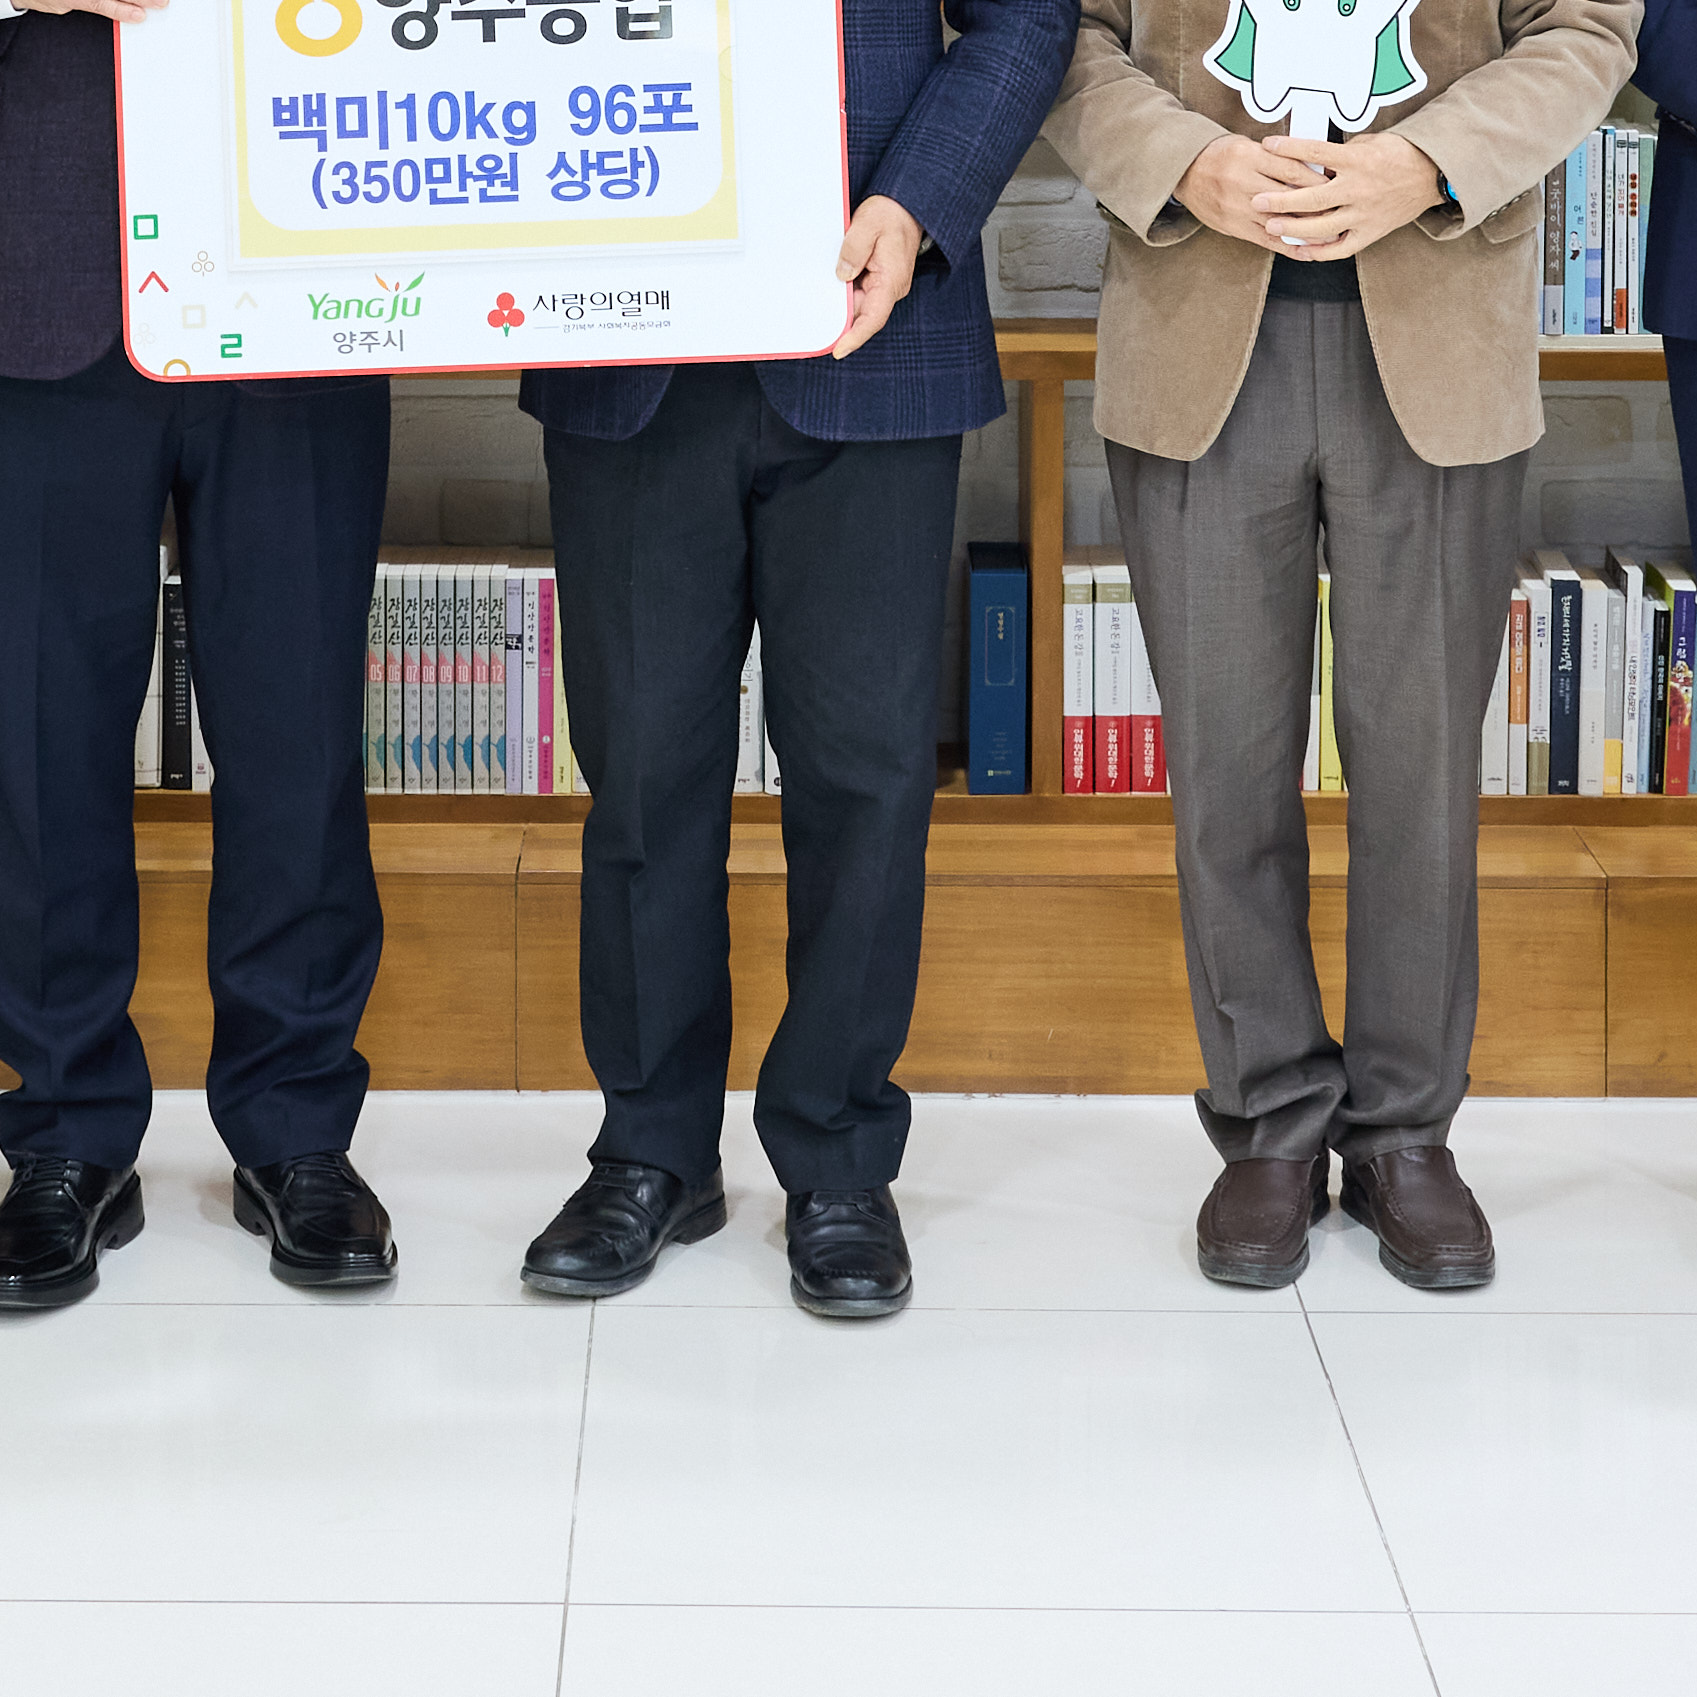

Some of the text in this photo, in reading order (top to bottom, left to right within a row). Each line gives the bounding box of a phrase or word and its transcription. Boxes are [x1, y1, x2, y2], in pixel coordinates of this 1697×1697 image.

[270, 82, 700, 153] 백미10kg 96포
[310, 144, 661, 210] (350만원 상당)
[532, 290, 671, 320] 사랑의열매
[332, 328, 405, 355] 양주시
[370, 596, 383, 682] 장길산 05
[388, 596, 401, 646] 장길산
[405, 596, 418, 646] 장길산
[423, 596, 436, 646] 장길산
[440, 596, 453, 646] 장길산
[457, 596, 470, 646] 장길산
[475, 596, 488, 646] 장길산
[490, 596, 504, 646] 장길산
[388, 664, 400, 682] 06
[406, 664, 418, 682] 07
[422, 664, 435, 682] 08
[440, 664, 452, 682] 09
[457, 664, 468, 682] 10
[475, 664, 487, 682] 11
[491, 664, 504, 682] 12
